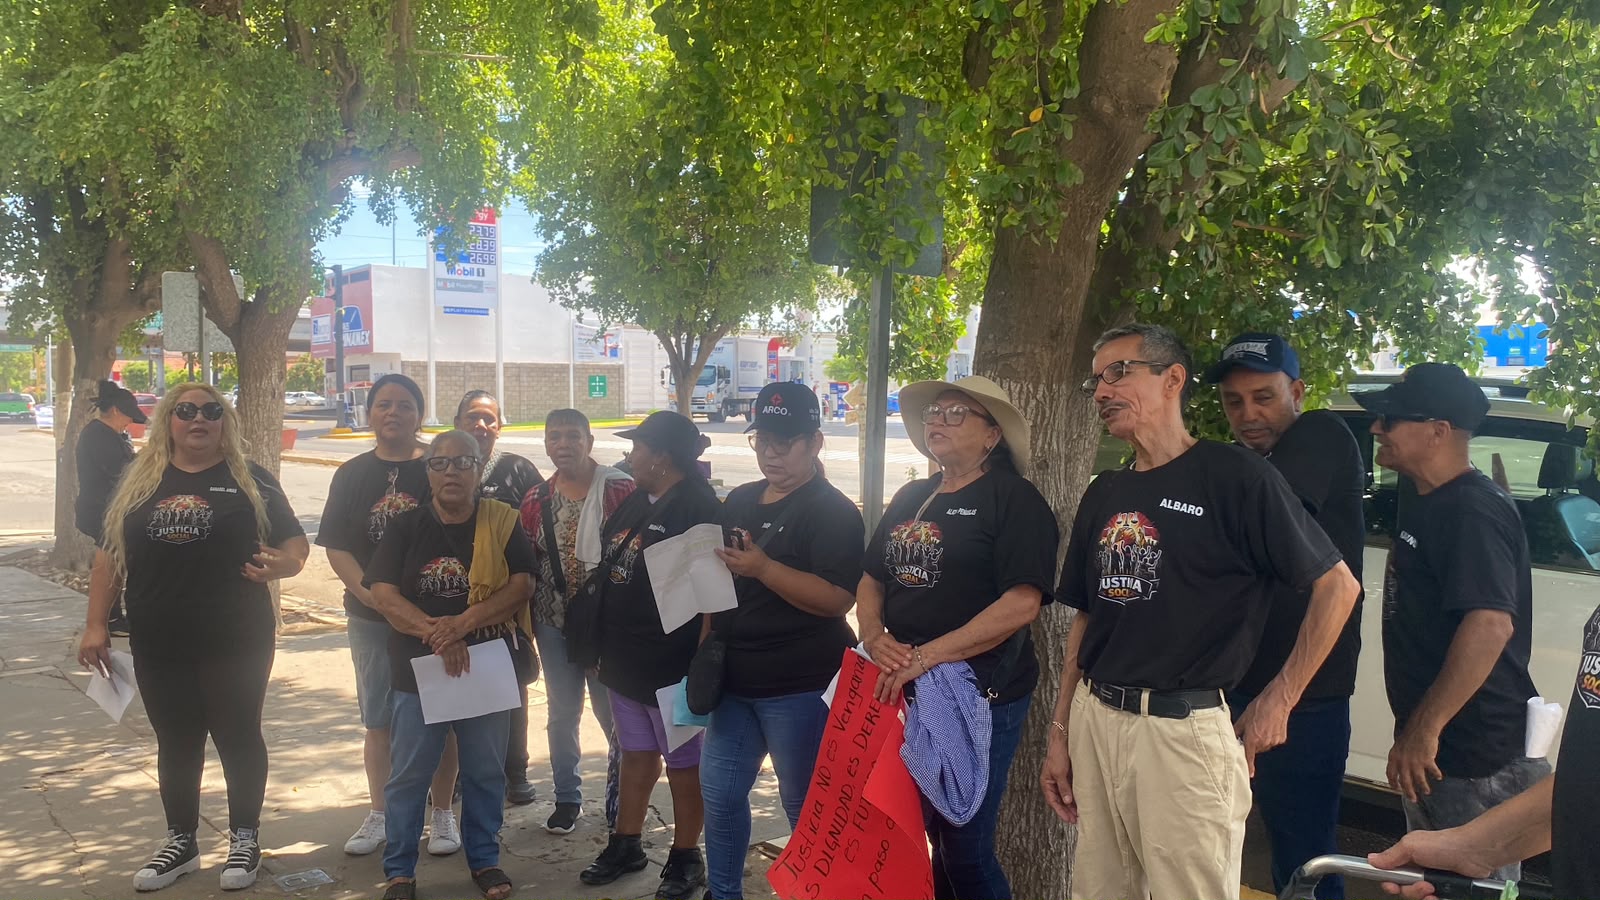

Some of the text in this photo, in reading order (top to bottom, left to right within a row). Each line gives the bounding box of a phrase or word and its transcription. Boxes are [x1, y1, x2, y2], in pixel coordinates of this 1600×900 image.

[447, 265, 475, 277] Mobil
[762, 405, 788, 416] ARCO
[1159, 498, 1204, 517] ALBARO
[156, 526, 200, 537] JUSTICIA
[895, 565, 929, 582] JUSTICIA
[853, 699, 881, 752] DERE
[816, 765, 832, 792] NO
[868, 839, 890, 894] paso
